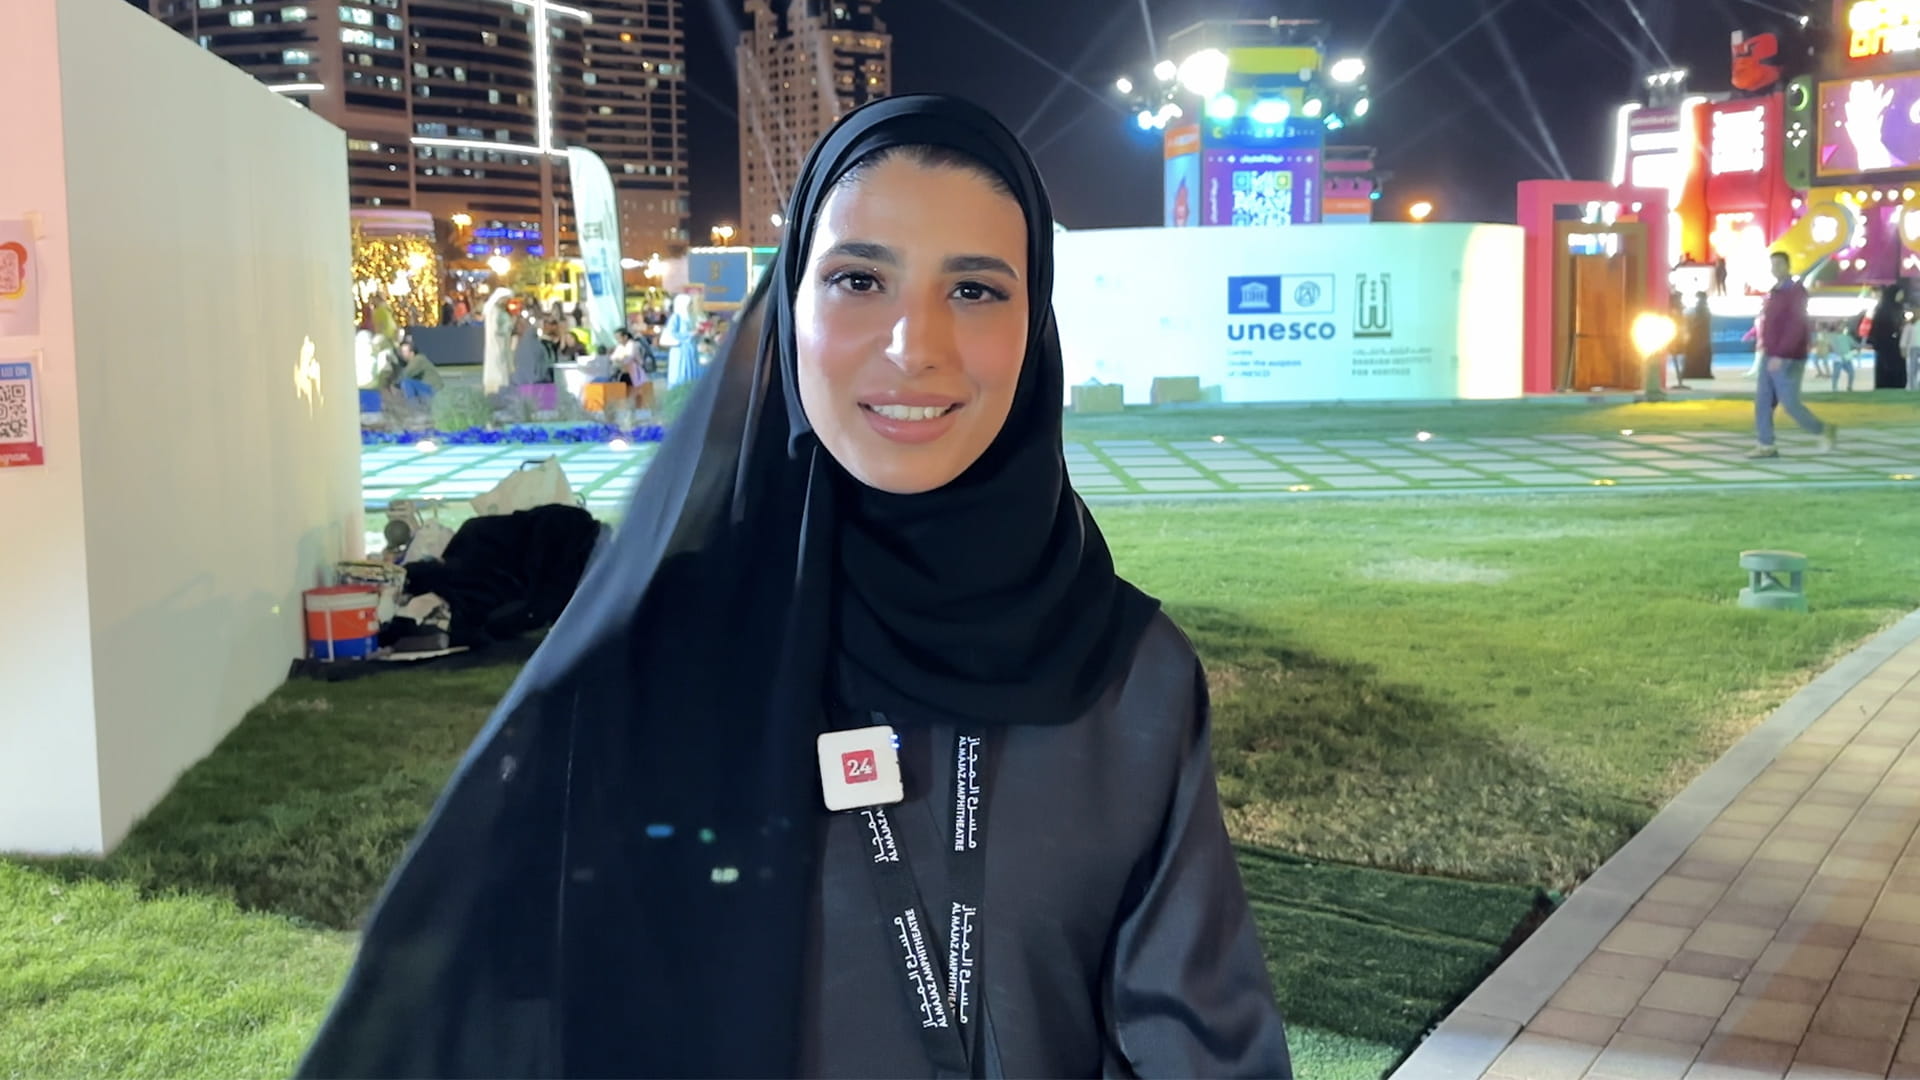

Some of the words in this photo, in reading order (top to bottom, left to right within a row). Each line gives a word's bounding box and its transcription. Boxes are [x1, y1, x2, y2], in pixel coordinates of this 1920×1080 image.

[1228, 322, 1335, 341] unesco
[847, 758, 872, 776] 24
[966, 736, 980, 794] المجاز
[955, 782, 967, 851] AMPHITHEATRE
[967, 797, 979, 849] مسرح
[904, 908, 935, 981] AMPHITHEATRE
[961, 904, 976, 967] المجاز
[894, 916, 919, 969] مسرح
[907, 970, 938, 1028] المجاز
[960, 970, 972, 1023] مسرح
